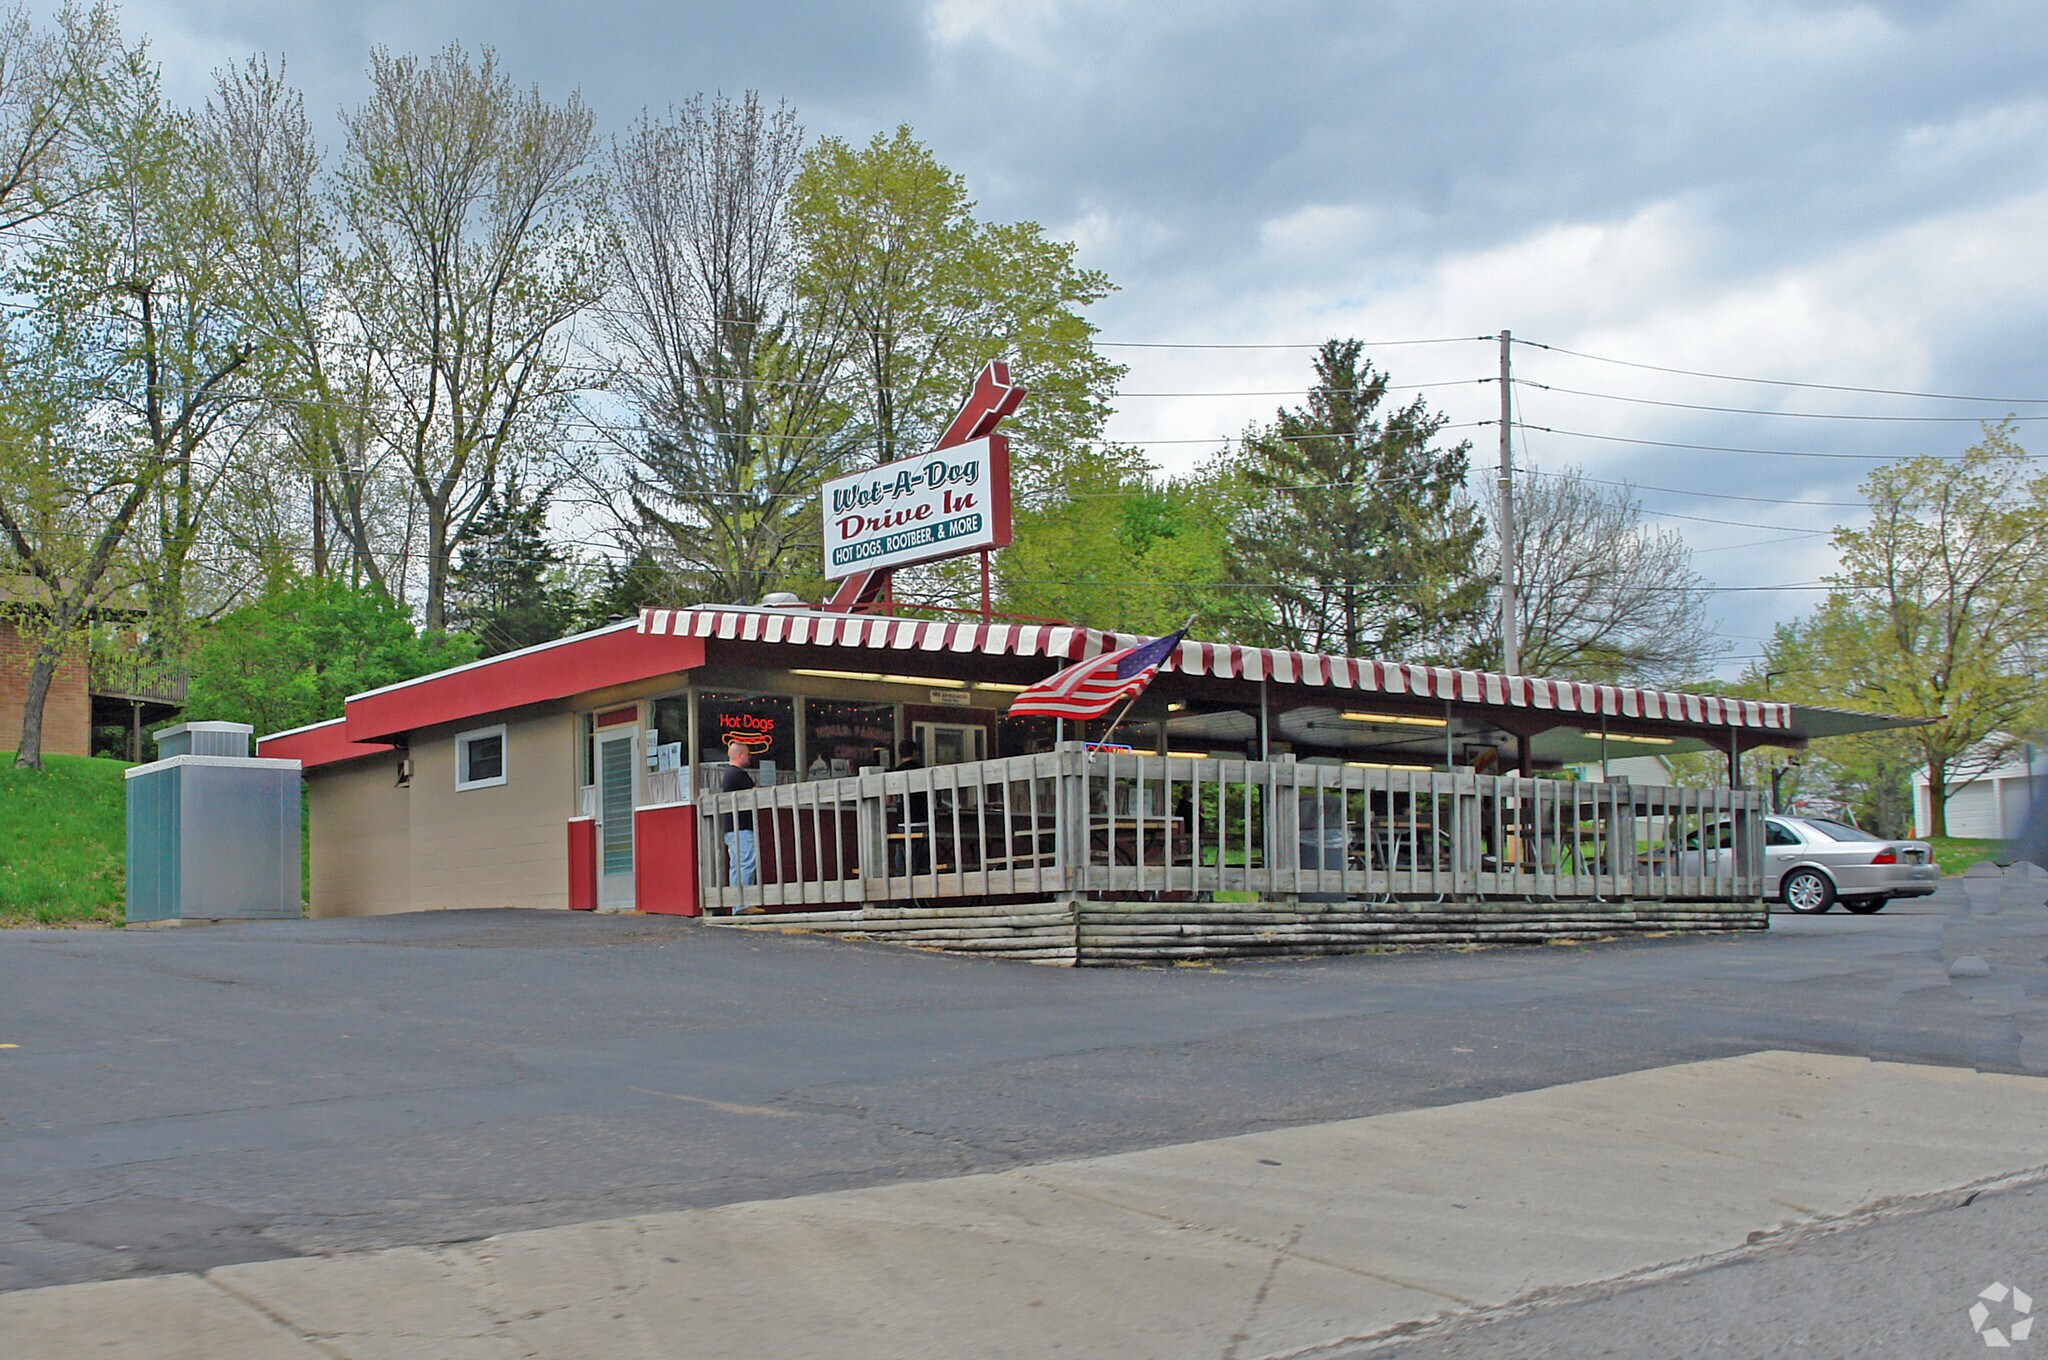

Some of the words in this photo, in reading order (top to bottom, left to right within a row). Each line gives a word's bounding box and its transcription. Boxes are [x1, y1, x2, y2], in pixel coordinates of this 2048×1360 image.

[833, 460, 979, 515] Wot-A-Dog
[835, 503, 933, 540] Drive
[943, 489, 978, 514] In
[835, 547, 853, 564] HOT
[856, 539, 884, 559] DOGS,
[886, 527, 935, 552] ROOTBEER,
[937, 524, 946, 539] &
[949, 515, 978, 537] MORE
[719, 713, 741, 728] Hot
[743, 713, 775, 733] Dogs
